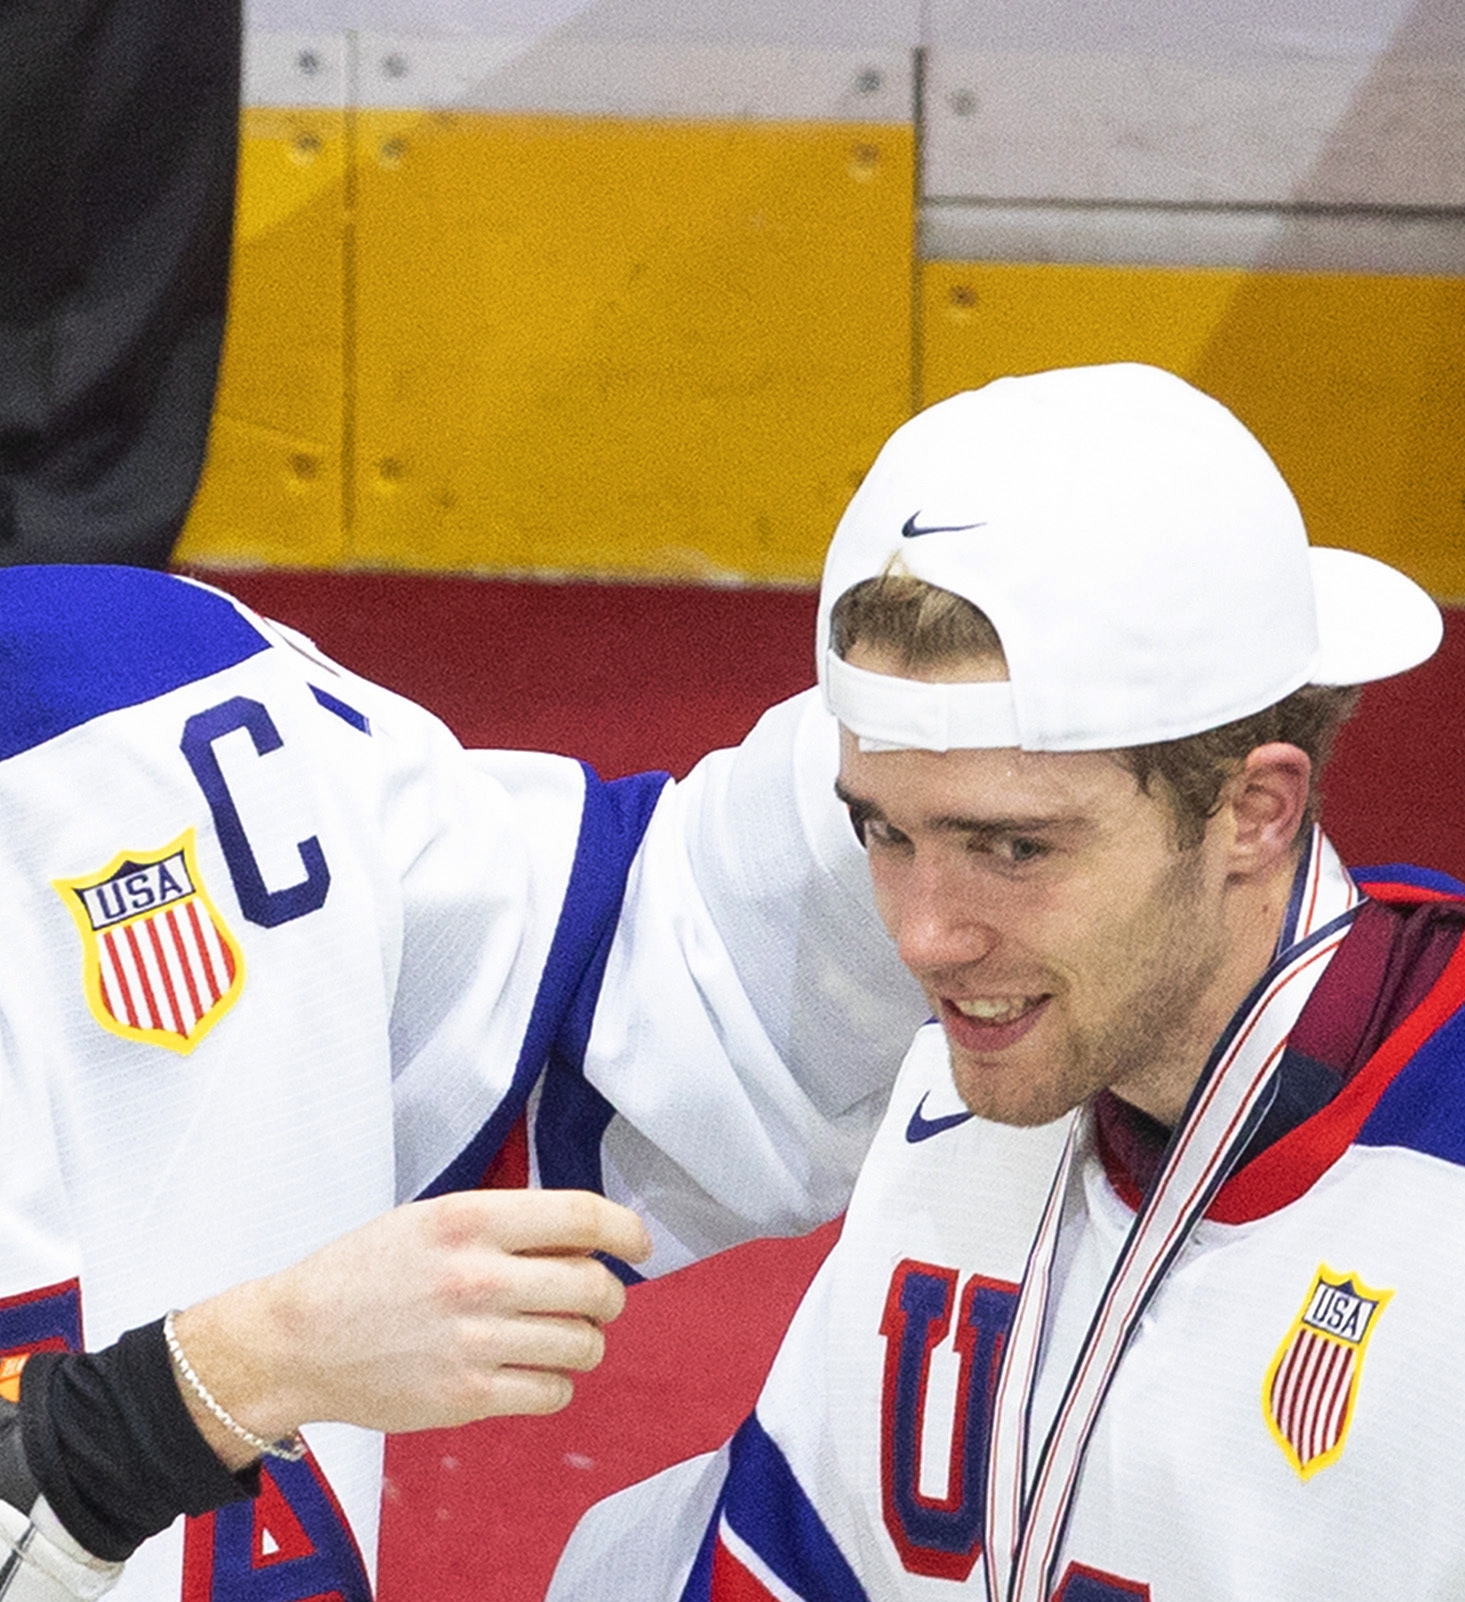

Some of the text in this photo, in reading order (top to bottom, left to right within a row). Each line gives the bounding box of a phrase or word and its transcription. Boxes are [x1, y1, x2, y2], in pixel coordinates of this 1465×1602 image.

[179, 695, 331, 930] C
[95, 861, 184, 920] USA
[1312, 1286, 1363, 1337] USA
